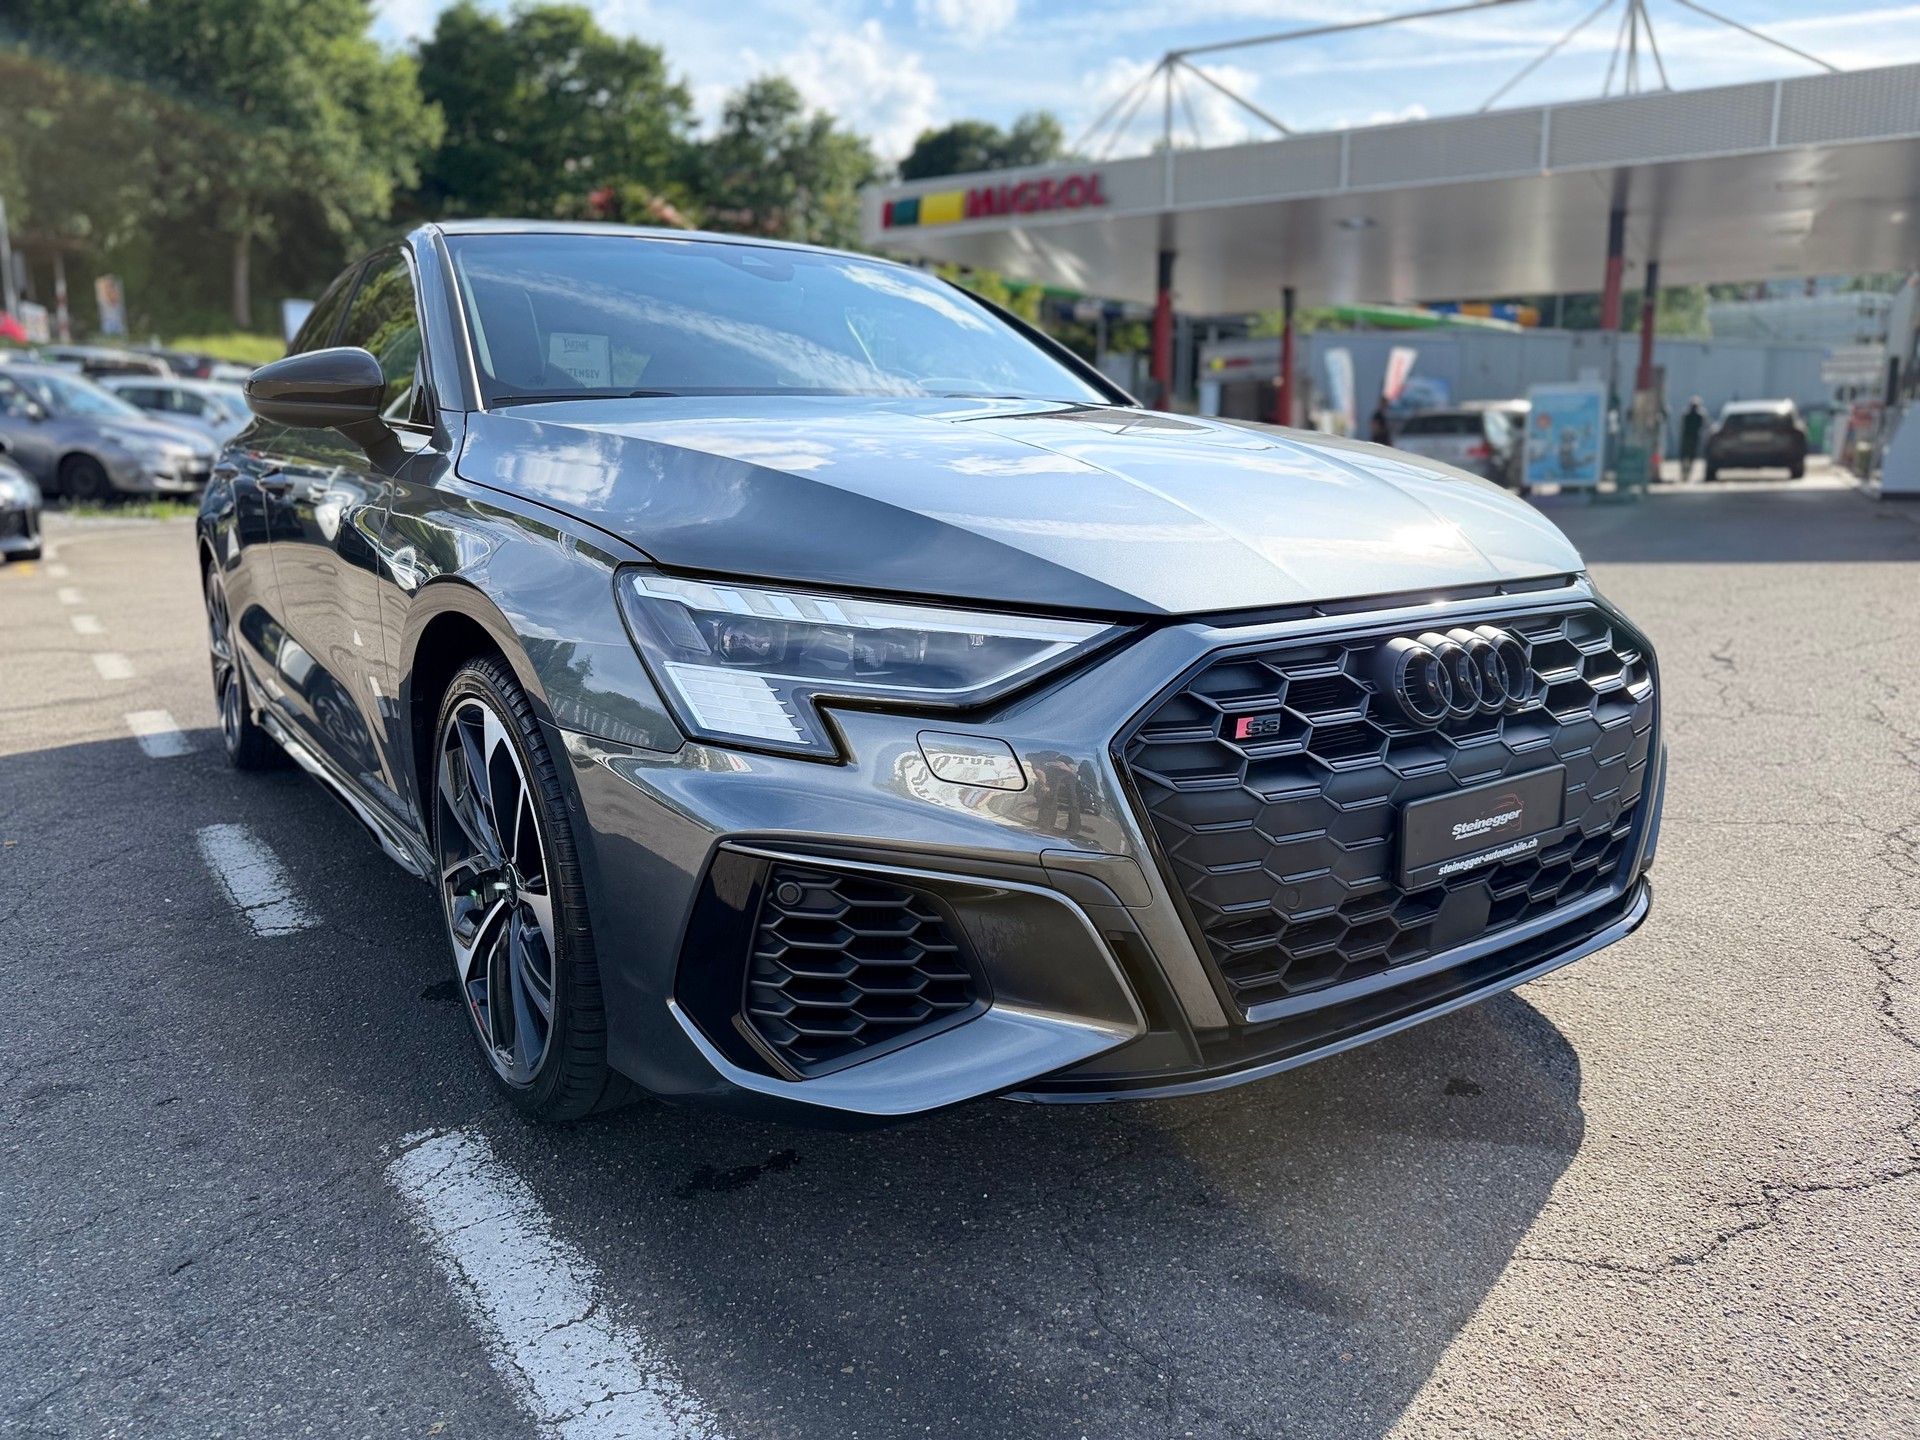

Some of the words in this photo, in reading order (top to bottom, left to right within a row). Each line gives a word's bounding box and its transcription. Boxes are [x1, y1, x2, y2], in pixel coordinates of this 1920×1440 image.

[966, 173, 1106, 219] MIGROL
[1246, 719, 1280, 735] S3
[1451, 808, 1522, 836] Steinegger
[1455, 826, 1492, 841] Automobile
[1438, 838, 1538, 876] steinegger-automobile.ch
